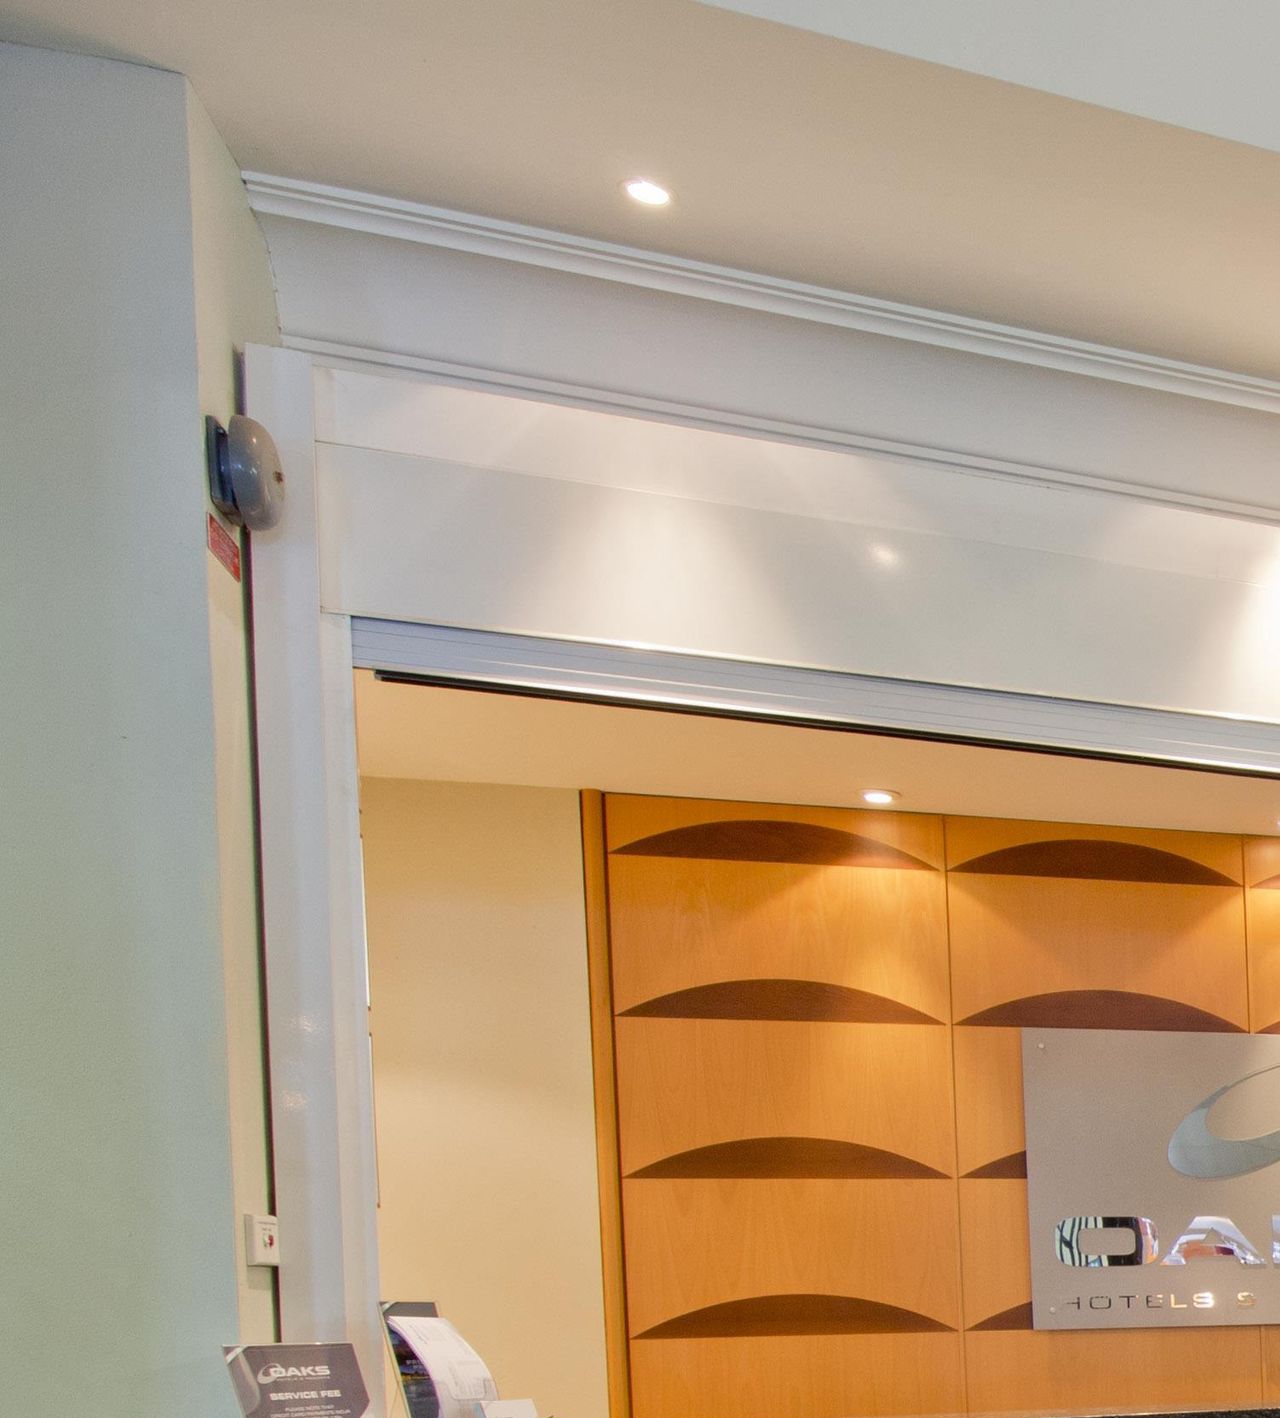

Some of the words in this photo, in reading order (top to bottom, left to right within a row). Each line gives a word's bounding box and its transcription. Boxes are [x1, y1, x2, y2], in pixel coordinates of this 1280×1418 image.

[1066, 1291, 1217, 1311] HOTELS
[269, 1365, 331, 1377] OAKS
[269, 1391, 318, 1400] SERVICE
[320, 1389, 342, 1398] FEE
